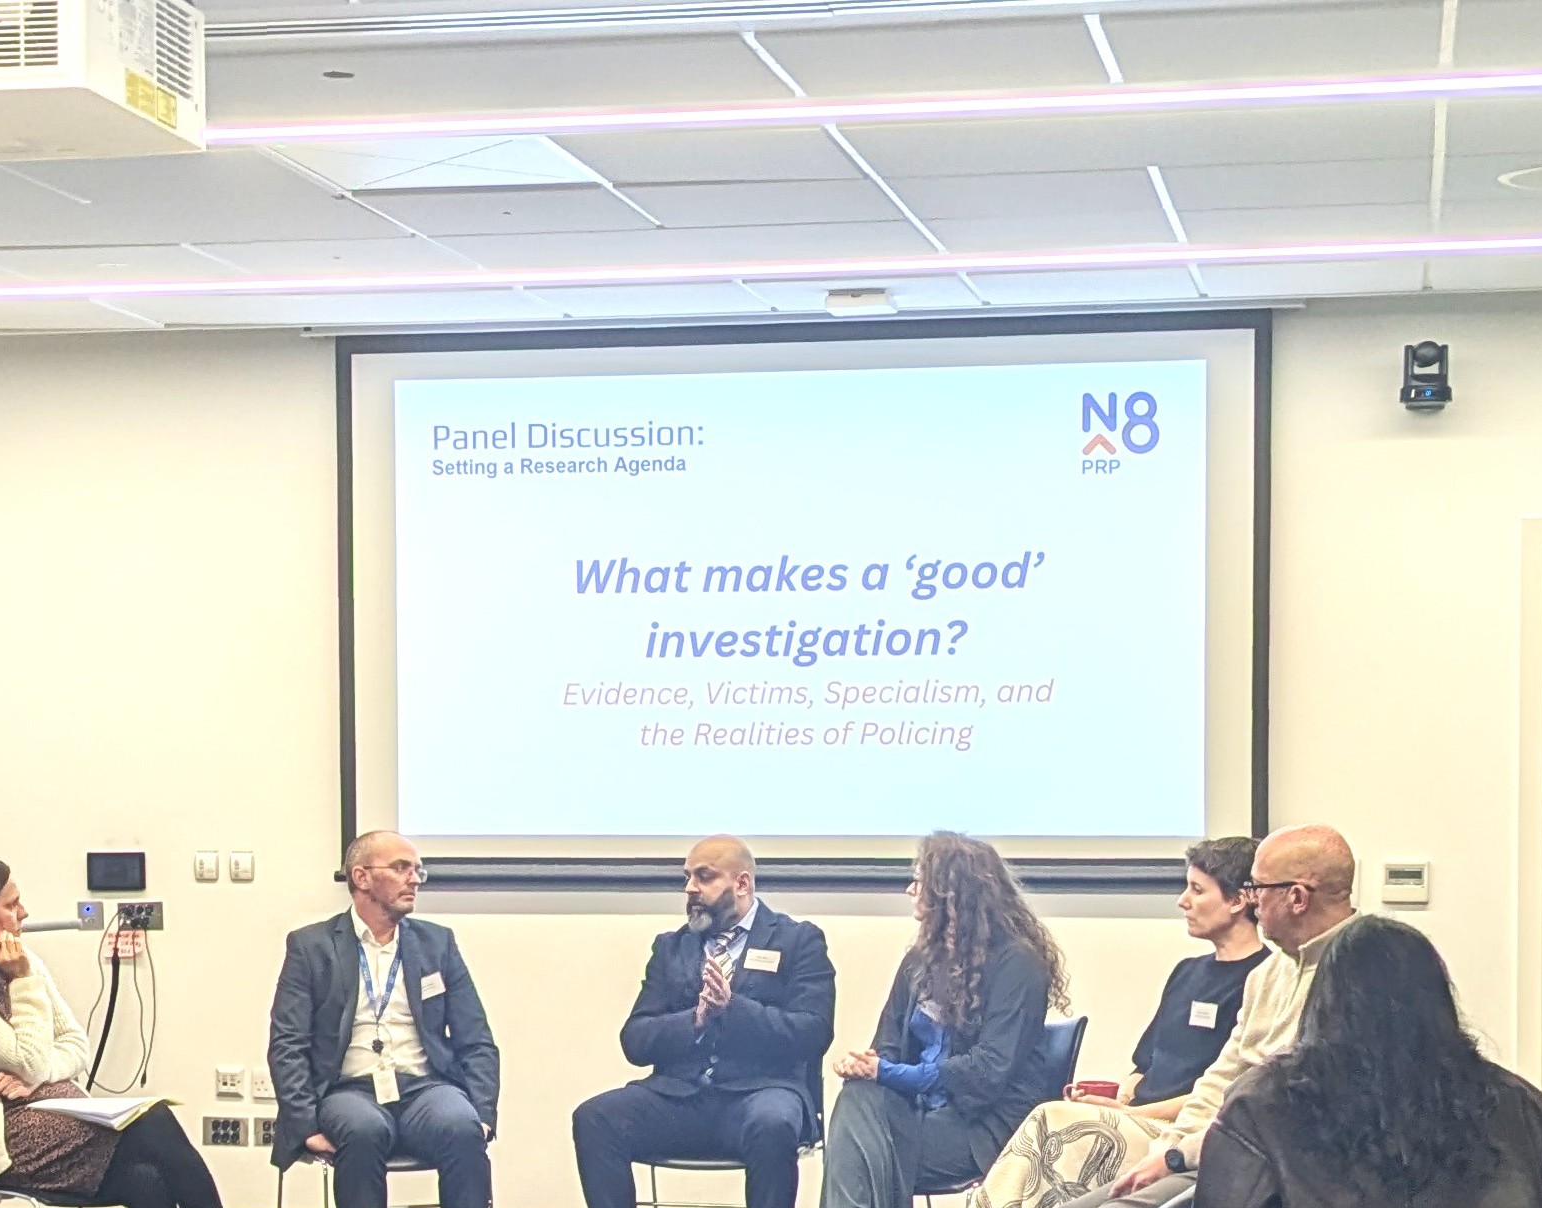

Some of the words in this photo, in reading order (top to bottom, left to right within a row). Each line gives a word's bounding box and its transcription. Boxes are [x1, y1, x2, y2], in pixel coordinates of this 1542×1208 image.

[432, 422, 516, 451] Panel
[527, 420, 704, 449] Discussion:
[1082, 391, 1160, 454] N8
[432, 458, 497, 479] Setting
[503, 461, 514, 475] a
[520, 457, 608, 474] Research
[614, 455, 687, 477] Agenda
[1082, 459, 1121, 474] PRP
[575, 557, 692, 595] What
[702, 555, 849, 593] makes
[861, 563, 890, 591] a
[645, 619, 969, 667] investigation?
[563, 682, 695, 709] Evidence,
[706, 681, 815, 708] Victims,
[824, 679, 987, 710] Specialism,
[997, 678, 1055, 703] and
[641, 723, 685, 746] the
[694, 721, 815, 746] Realities
[823, 721, 854, 745] of
[860, 719, 974, 752] Policing
